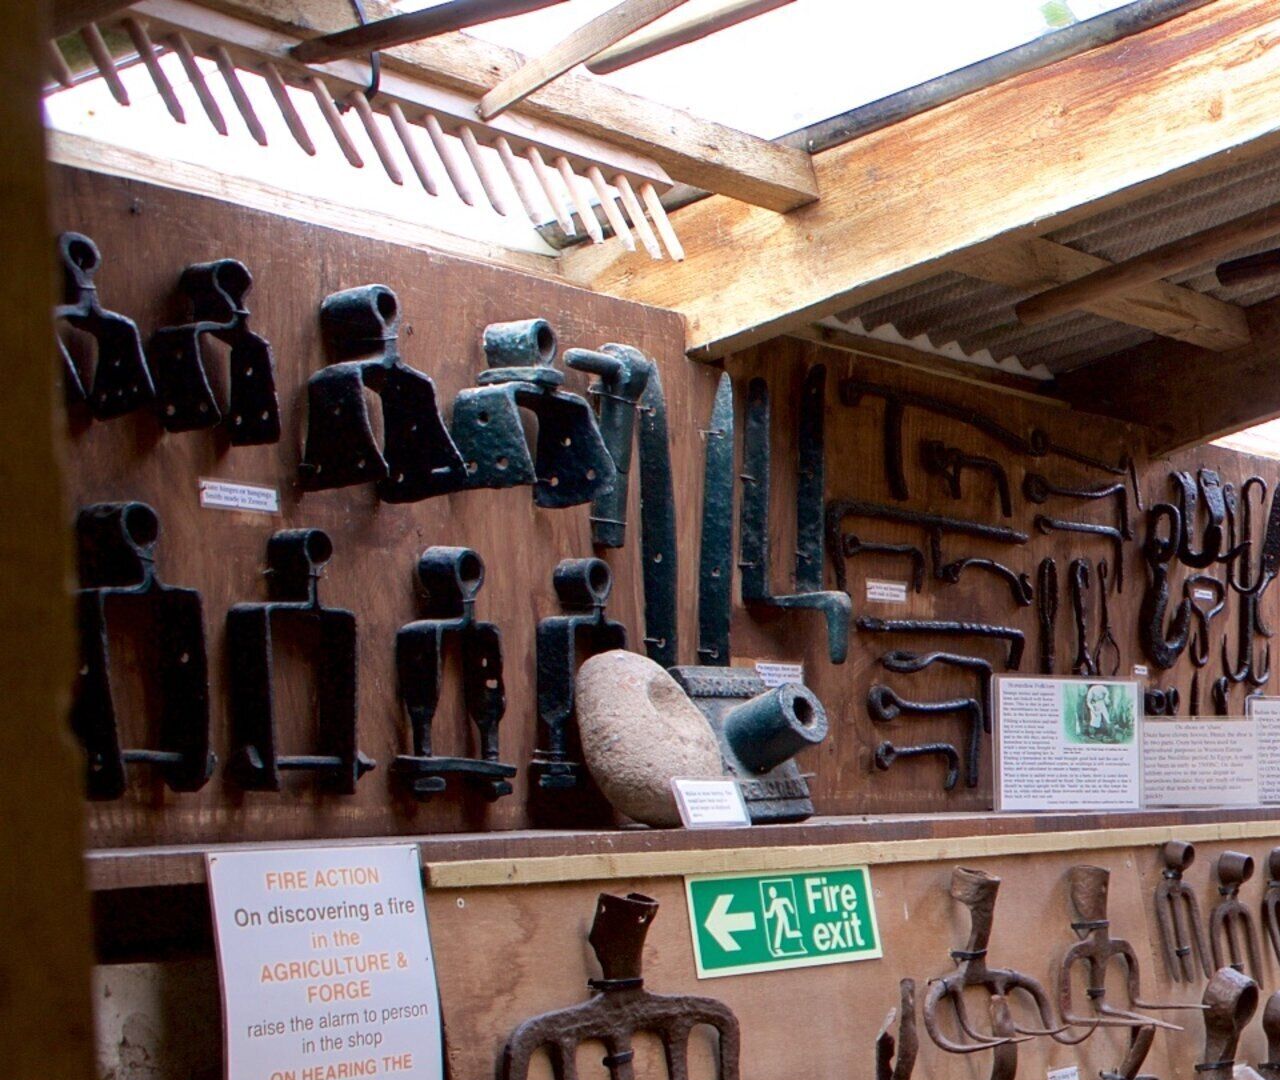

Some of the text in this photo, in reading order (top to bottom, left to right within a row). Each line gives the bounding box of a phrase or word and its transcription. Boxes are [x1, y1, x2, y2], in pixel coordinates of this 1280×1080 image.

[267, 867, 380, 890] FIRE ACTION
[804, 877, 857, 914] Fire
[234, 899, 415, 927] On discovering a fire
[312, 929, 360, 948] in the
[812, 911, 865, 951] exit
[261, 951, 408, 983] AGRICULTURE &
[307, 980, 372, 1003] FORGE
[247, 1002, 428, 1038] raise the alarm to person
[302, 1031, 383, 1053] in the shop
[382, 1054, 413, 1073] THE
